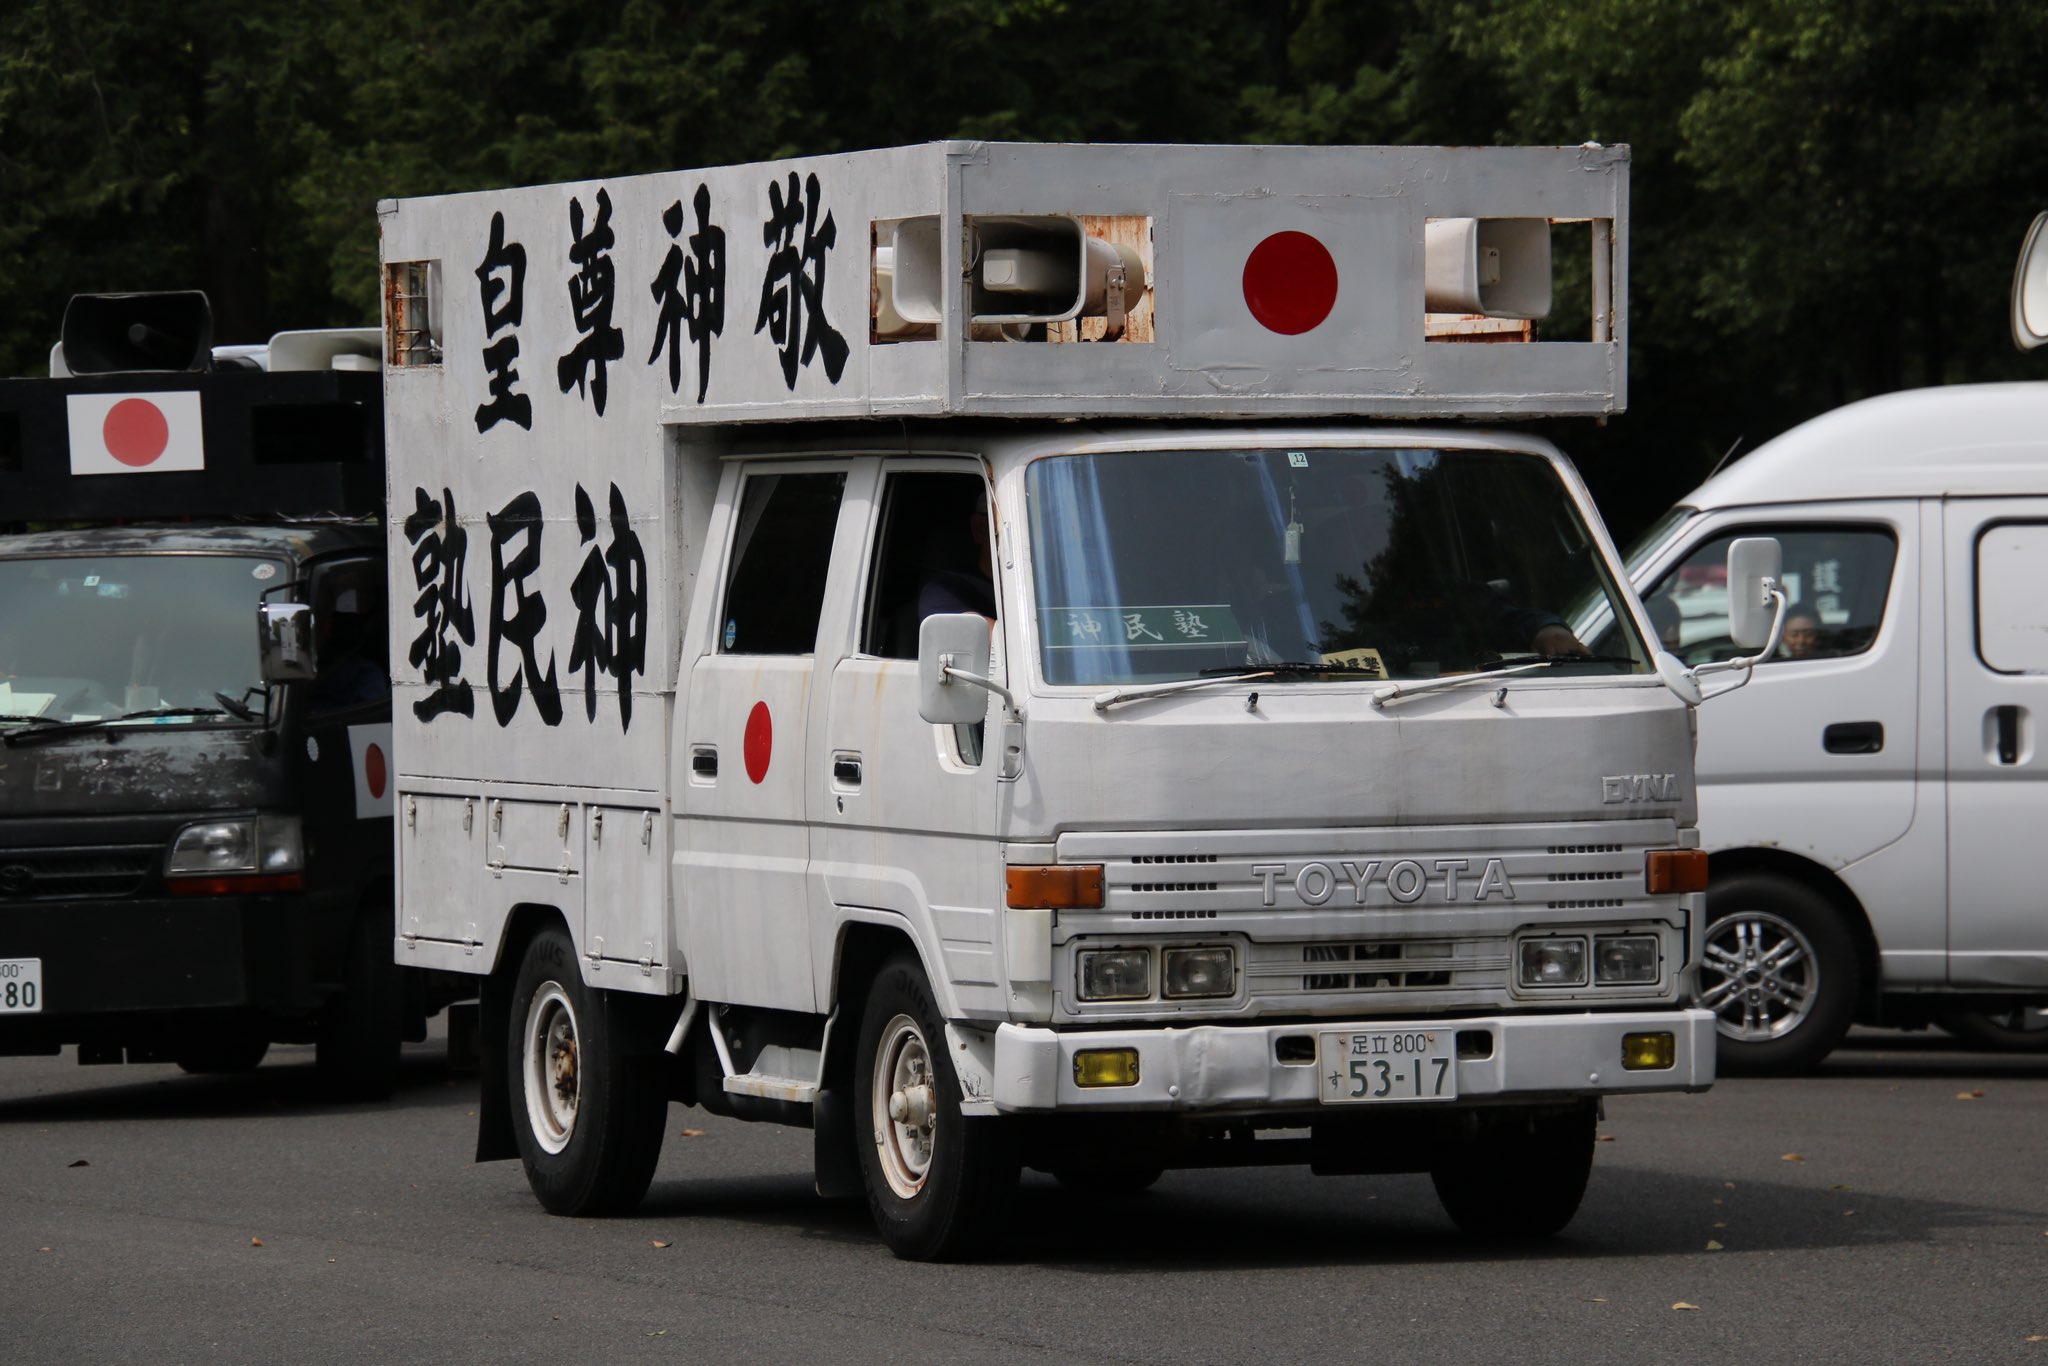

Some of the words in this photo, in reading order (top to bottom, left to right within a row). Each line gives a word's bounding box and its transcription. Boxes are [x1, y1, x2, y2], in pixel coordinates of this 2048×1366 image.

[1294, 453, 1305, 462] 12
[1067, 610, 1209, 641] 神民塾
[1252, 858, 1516, 906] TOYOTA
[1328, 1071, 1343, 1090] す
[1350, 1058, 1449, 1097] 53-17
